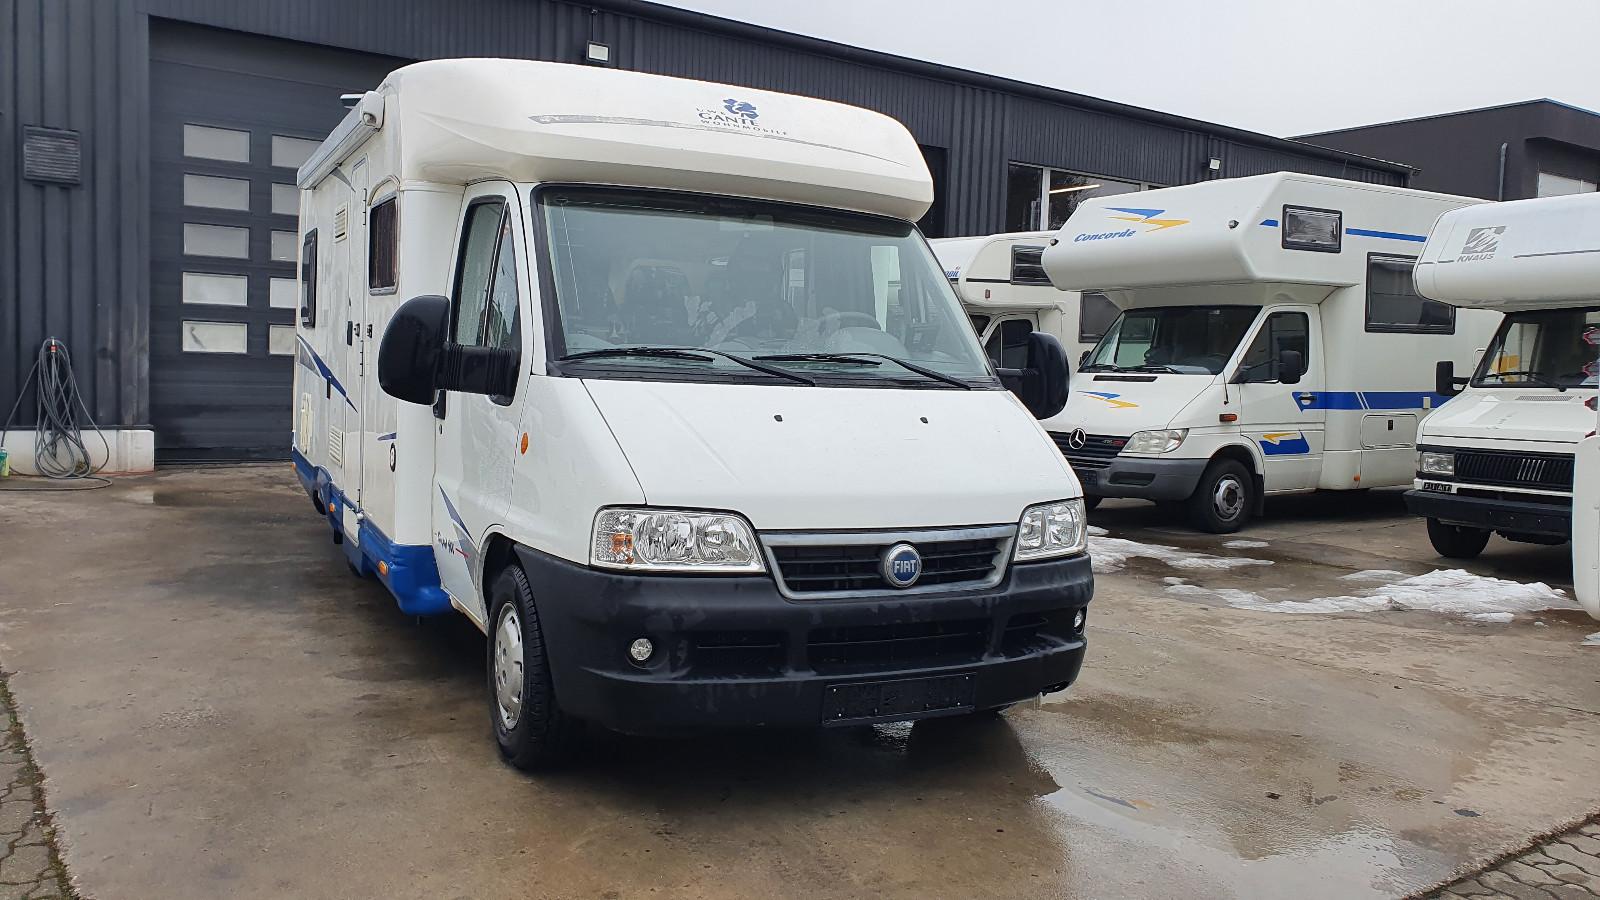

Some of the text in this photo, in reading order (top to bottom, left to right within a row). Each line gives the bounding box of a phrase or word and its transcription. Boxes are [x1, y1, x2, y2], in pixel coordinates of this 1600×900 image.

[698, 112, 760, 127] GANTE
[1074, 228, 1136, 243] Concorde
[1457, 253, 1494, 263] KNAUS
[1424, 483, 1451, 492] FIAT
[893, 559, 917, 574] FIAT
